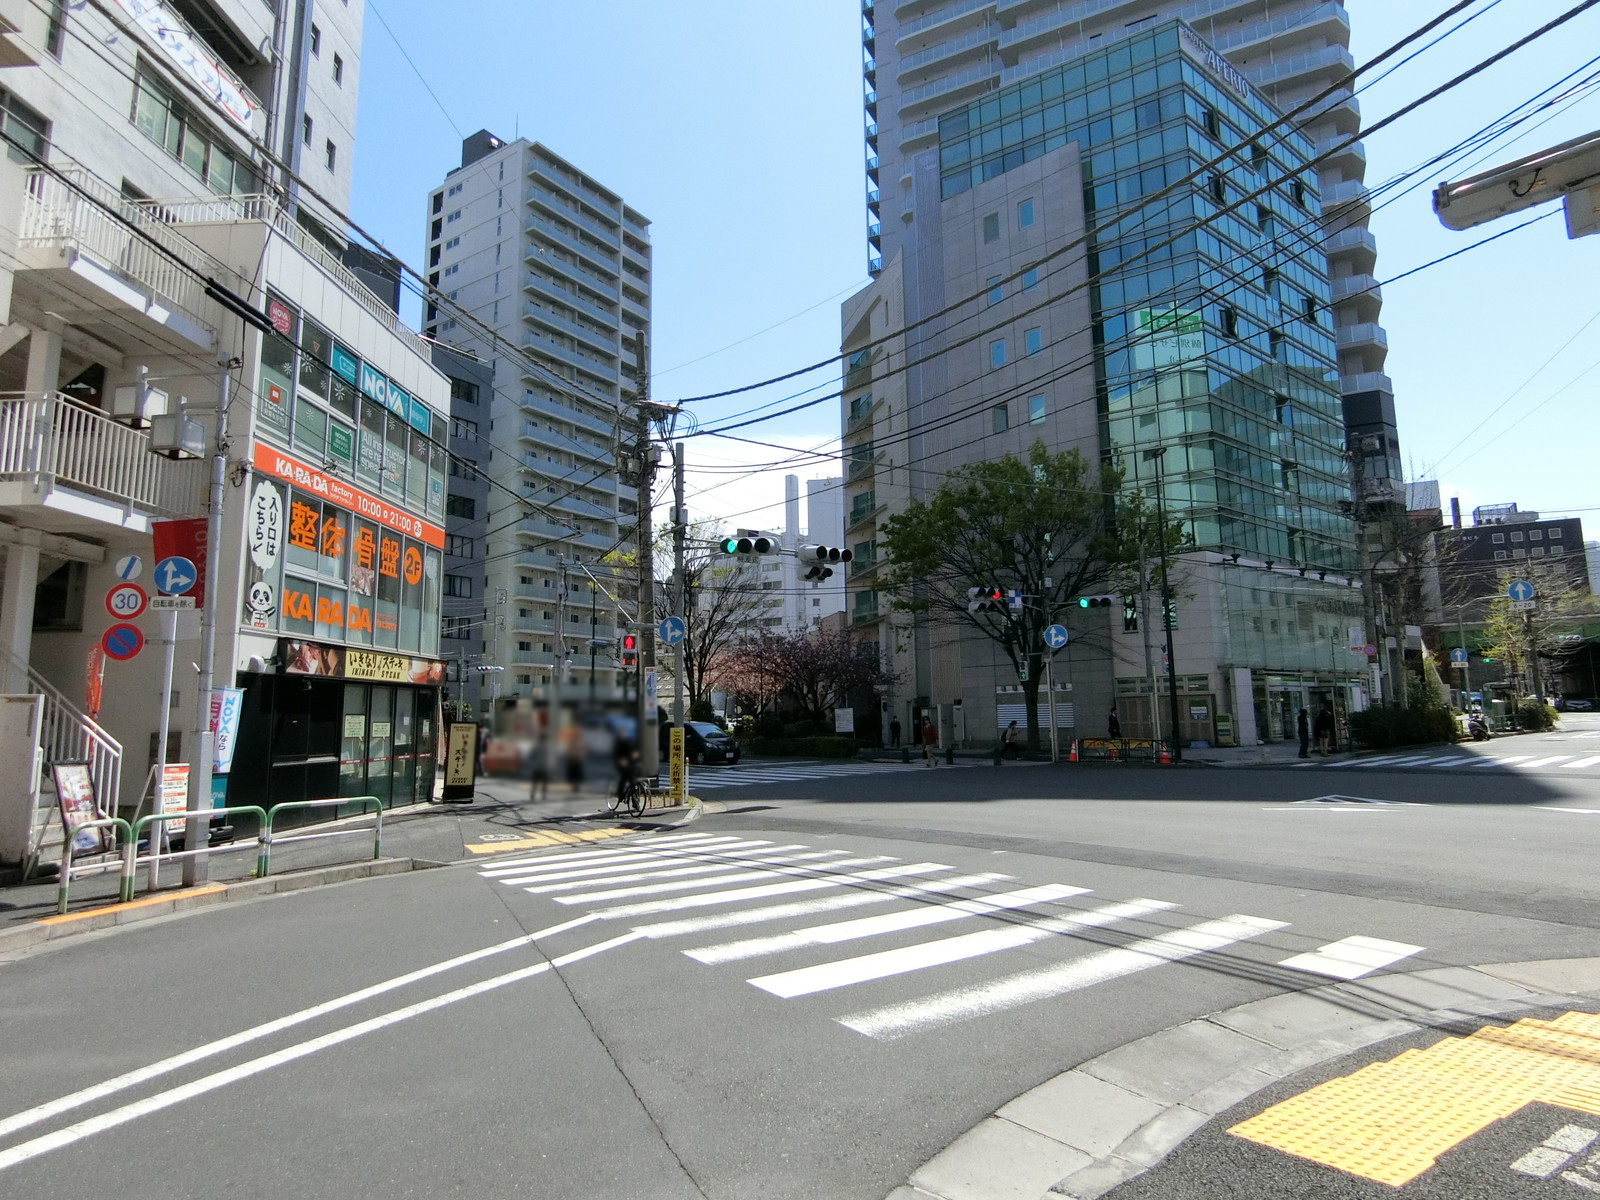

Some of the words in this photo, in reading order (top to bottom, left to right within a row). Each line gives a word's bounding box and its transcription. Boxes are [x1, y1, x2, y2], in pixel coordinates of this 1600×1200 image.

[1208, 50, 1249, 98] APERTO
[365, 369, 404, 417] NOVA
[362, 431, 372, 446] All
[331, 482, 354, 500] factory
[256, 495, 266, 541] こちら
[358, 495, 382, 519] 10:00
[389, 511, 412, 532] 21:00
[290, 501, 346, 559] 整体
[354, 526, 400, 579] 骨盤
[405, 553, 421, 577] 2F
[115, 593, 138, 610] 30
